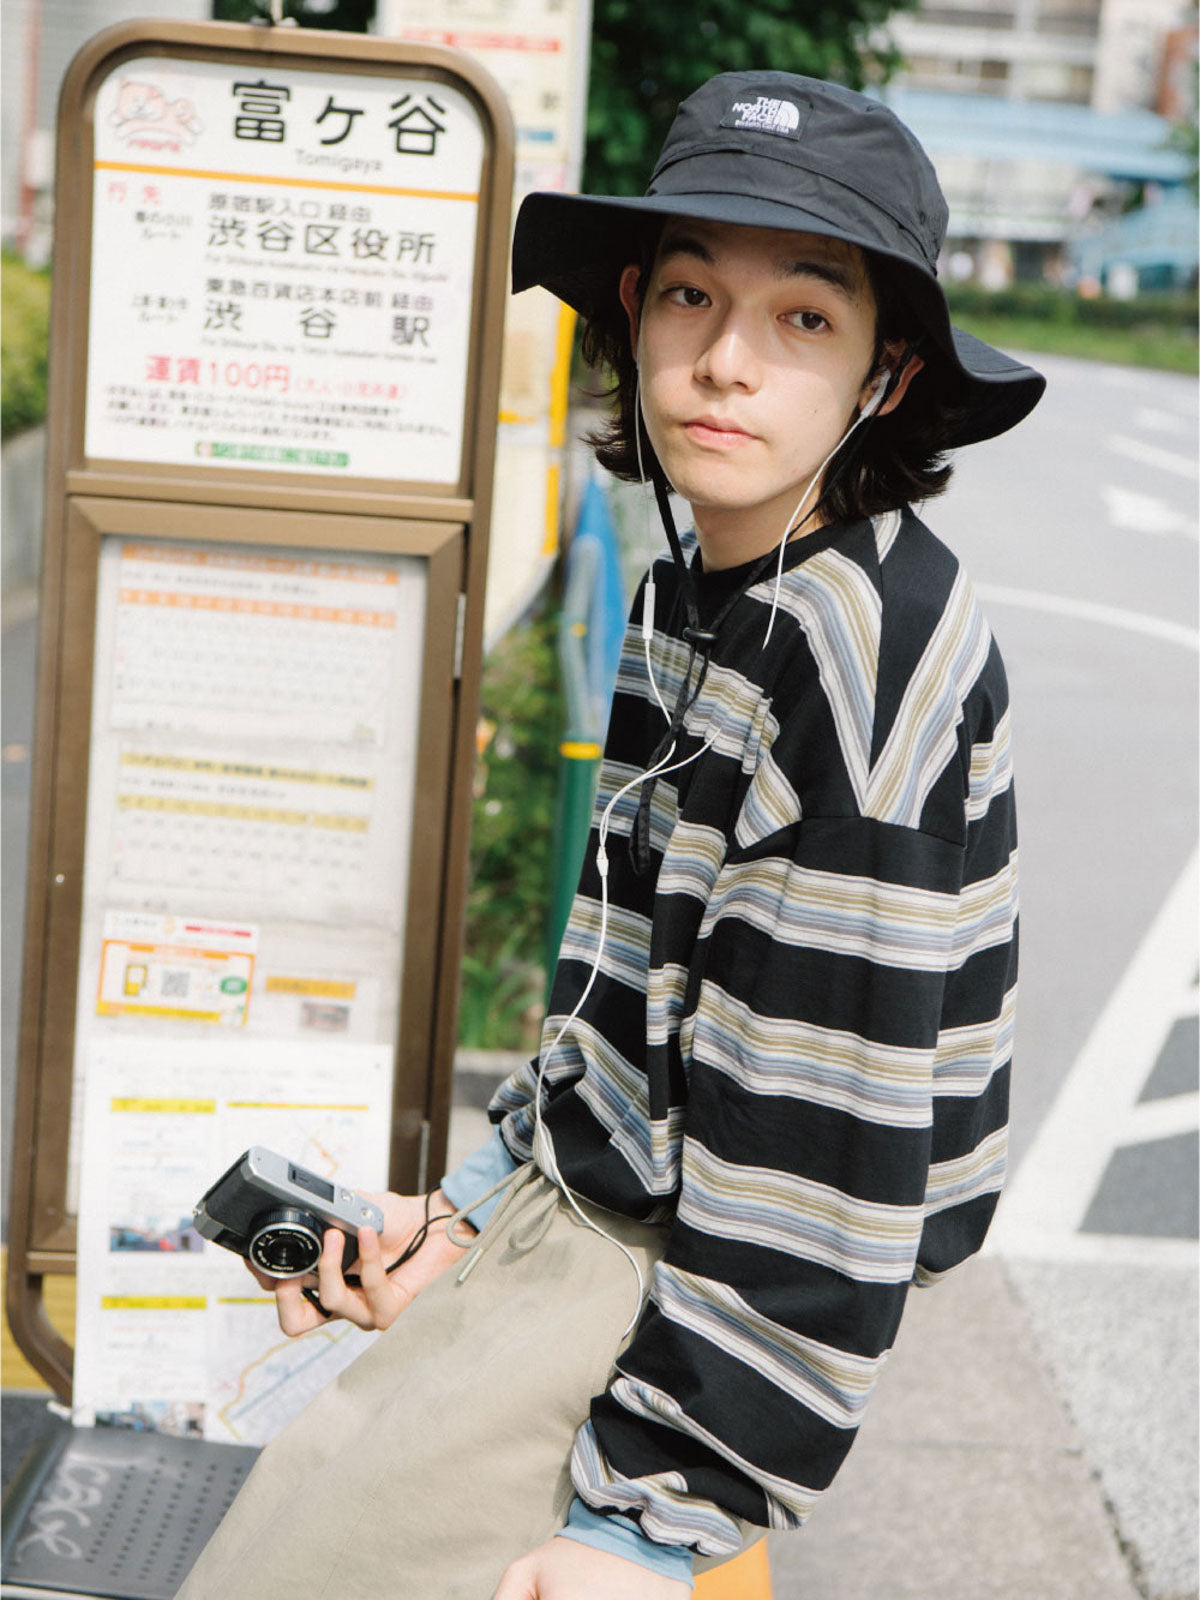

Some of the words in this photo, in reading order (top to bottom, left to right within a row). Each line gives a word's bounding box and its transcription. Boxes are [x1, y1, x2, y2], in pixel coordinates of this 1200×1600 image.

[732, 102, 777, 118] NORTH
[757, 96, 781, 108] THE
[741, 112, 775, 124] FACE
[295, 149, 383, 174] Tomigaya
[208, 216, 437, 264] 渋谷区役所
[203, 298, 432, 348] 渋谷駅
